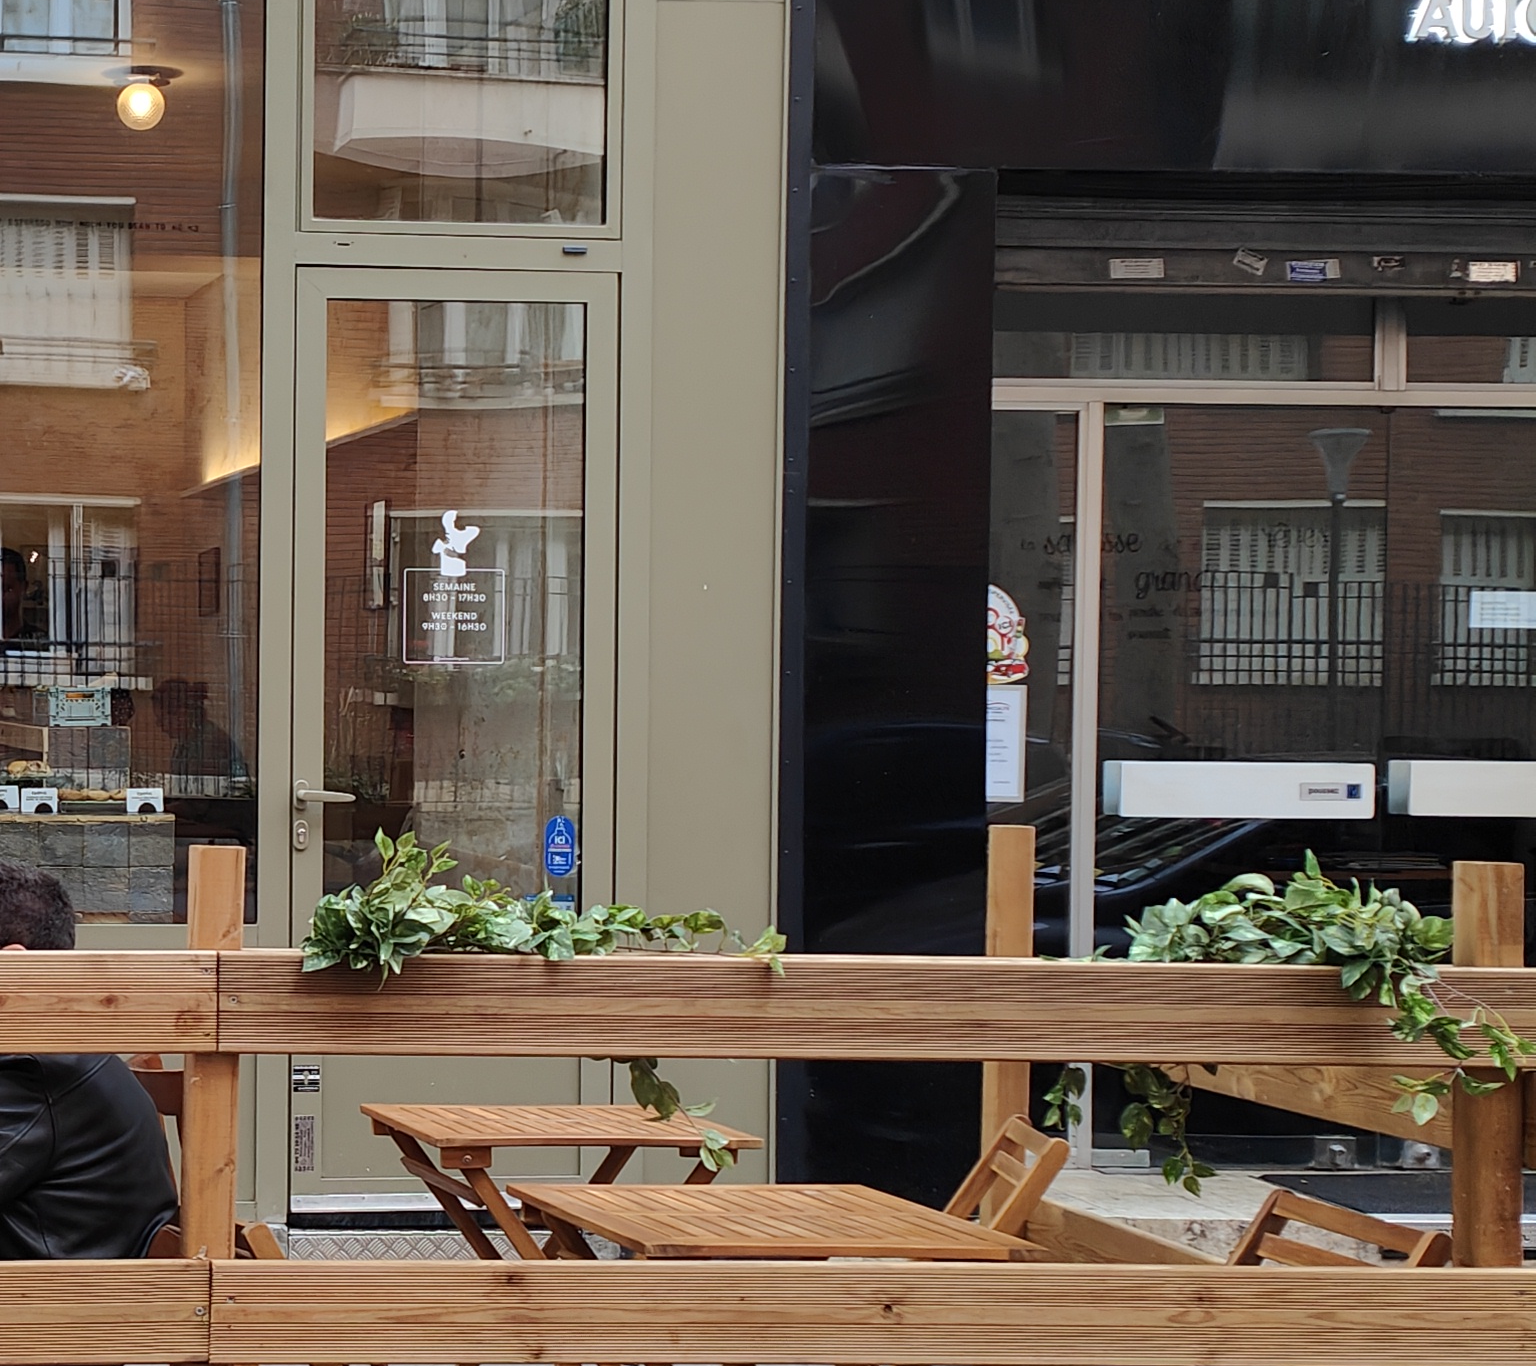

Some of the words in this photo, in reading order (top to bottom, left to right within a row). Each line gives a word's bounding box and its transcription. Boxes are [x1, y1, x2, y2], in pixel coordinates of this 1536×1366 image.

[1043, 532, 1143, 556] sasse
[433, 583, 476, 591] SEMAINE
[423, 593, 448, 602] 8H30
[458, 594, 486, 602] 17H30
[431, 612, 477, 620] WEEKEND
[422, 623, 447, 631] 9H30
[457, 623, 487, 631] 16H30
